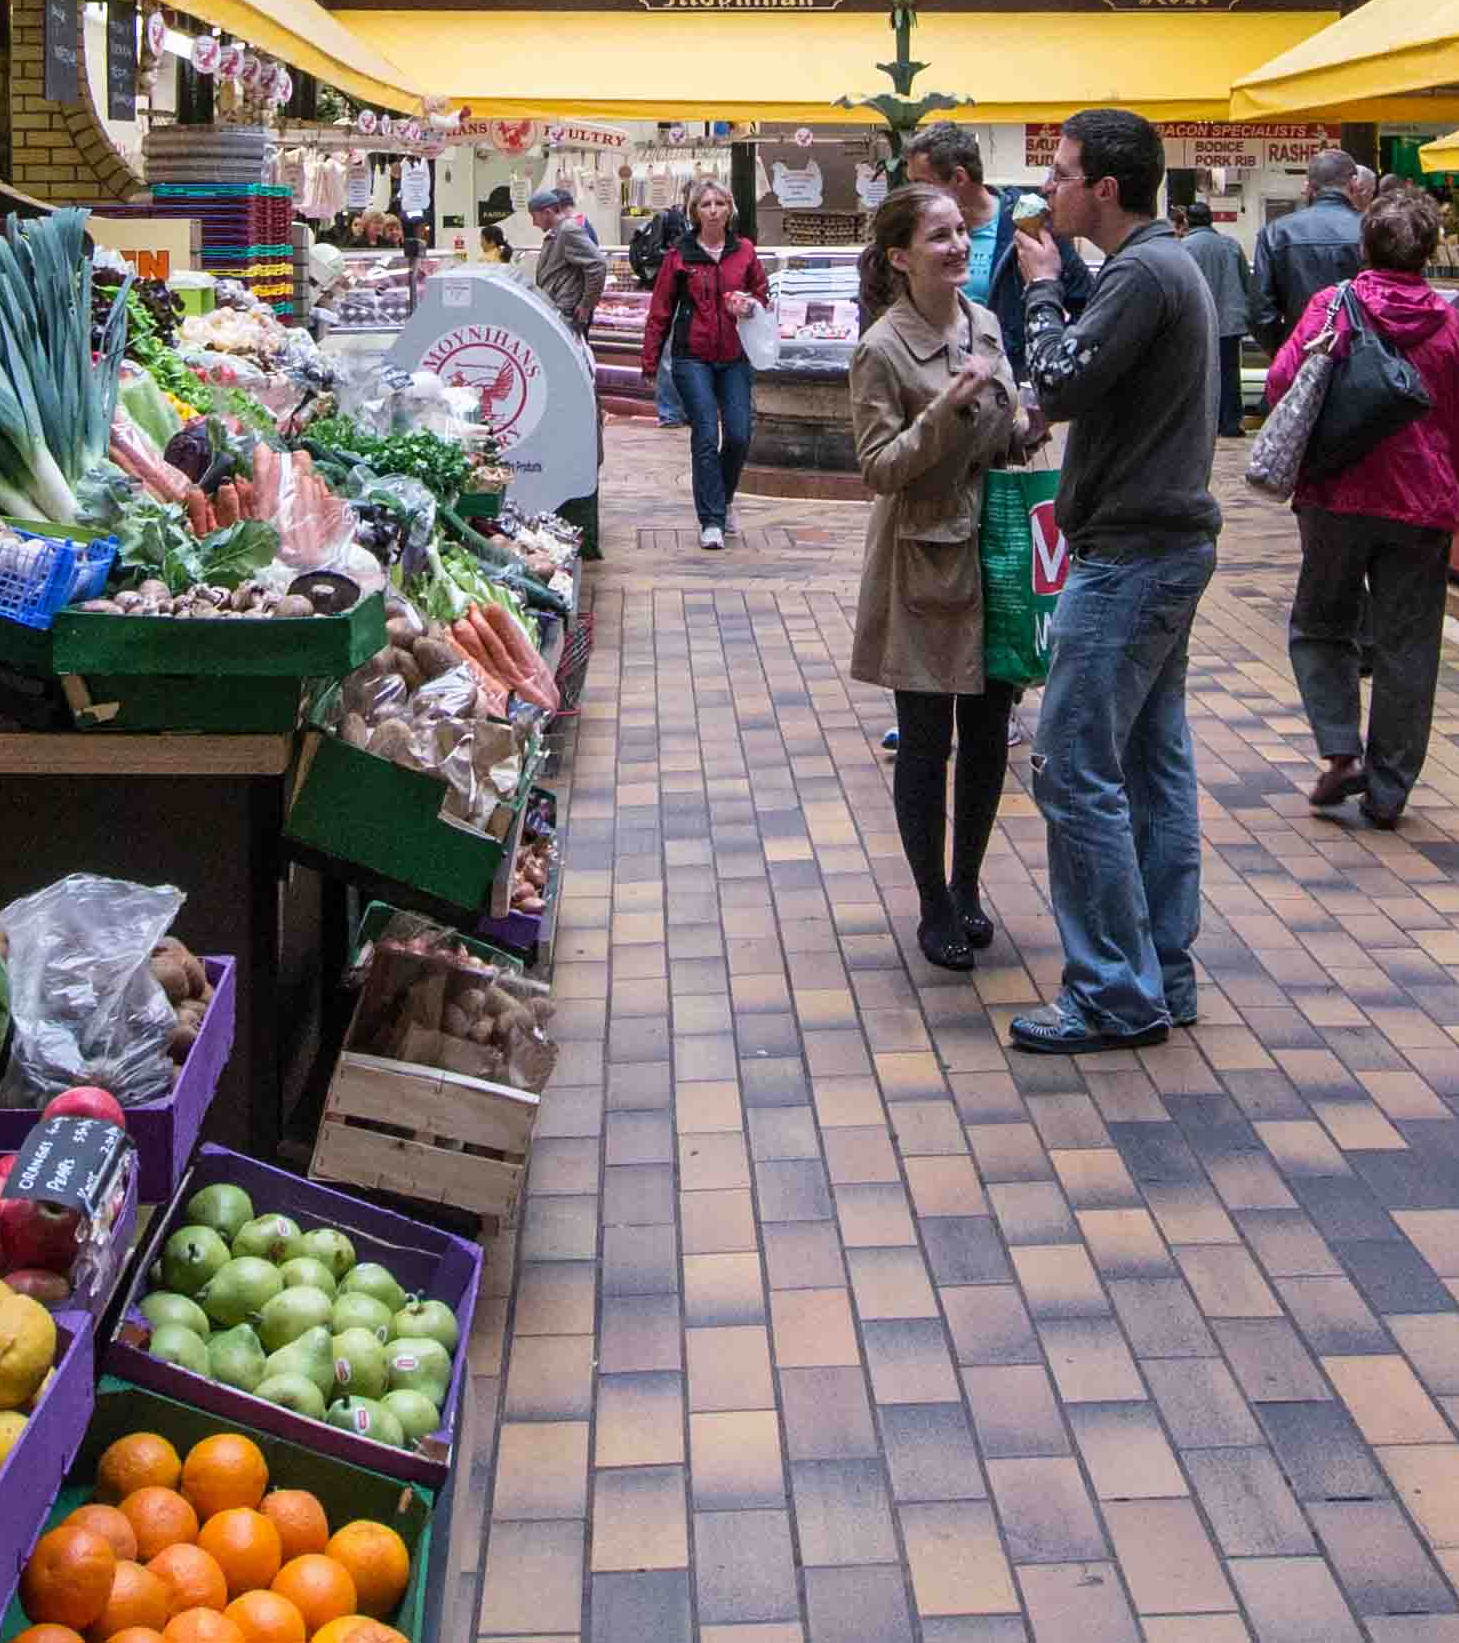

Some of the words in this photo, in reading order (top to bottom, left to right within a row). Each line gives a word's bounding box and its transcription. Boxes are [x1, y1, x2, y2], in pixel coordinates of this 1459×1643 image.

[543, 125, 627, 147] PULTRY
[1212, 123, 1308, 139] SPECIALISTS
[1194, 140, 1245, 153] BODICE
[1195, 155, 1232, 167] PORK
[1235, 155, 1256, 167] RIB
[422, 324, 541, 380] MOYNIHANS
